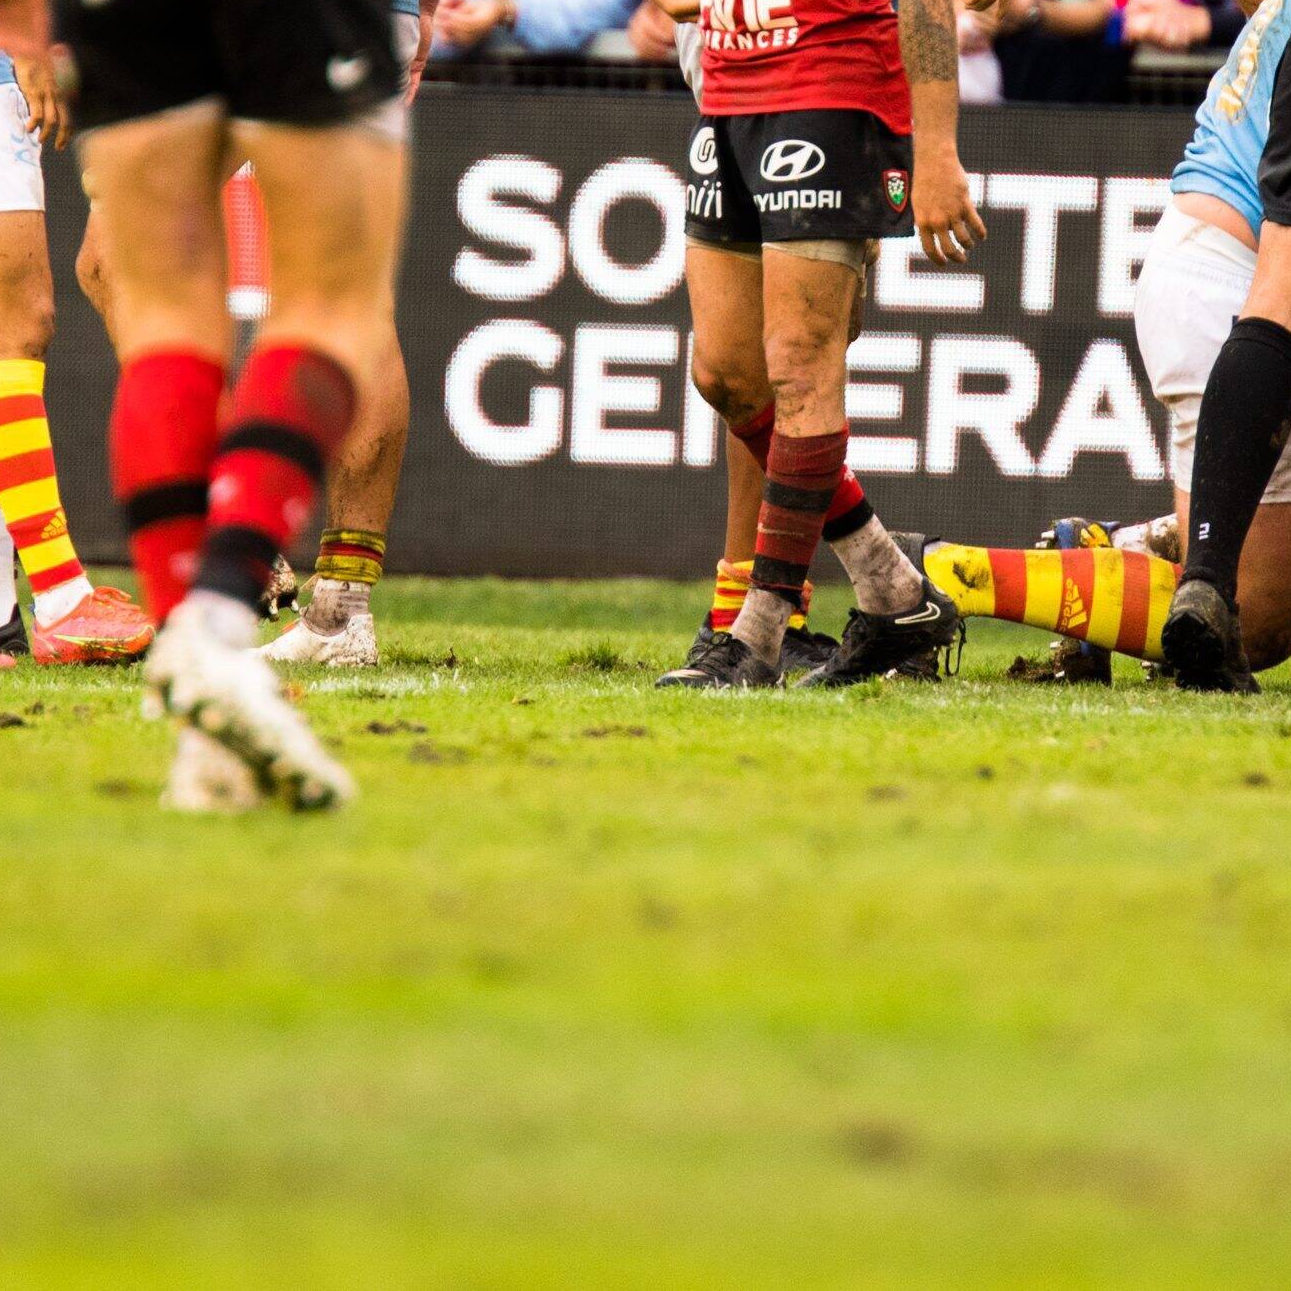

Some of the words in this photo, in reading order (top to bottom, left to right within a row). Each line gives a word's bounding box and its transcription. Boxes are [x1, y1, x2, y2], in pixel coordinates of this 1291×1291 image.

[452, 154, 1171, 316] SOETE
[686, 180, 723, 220] niti
[445, 318, 1179, 482] GEERA
